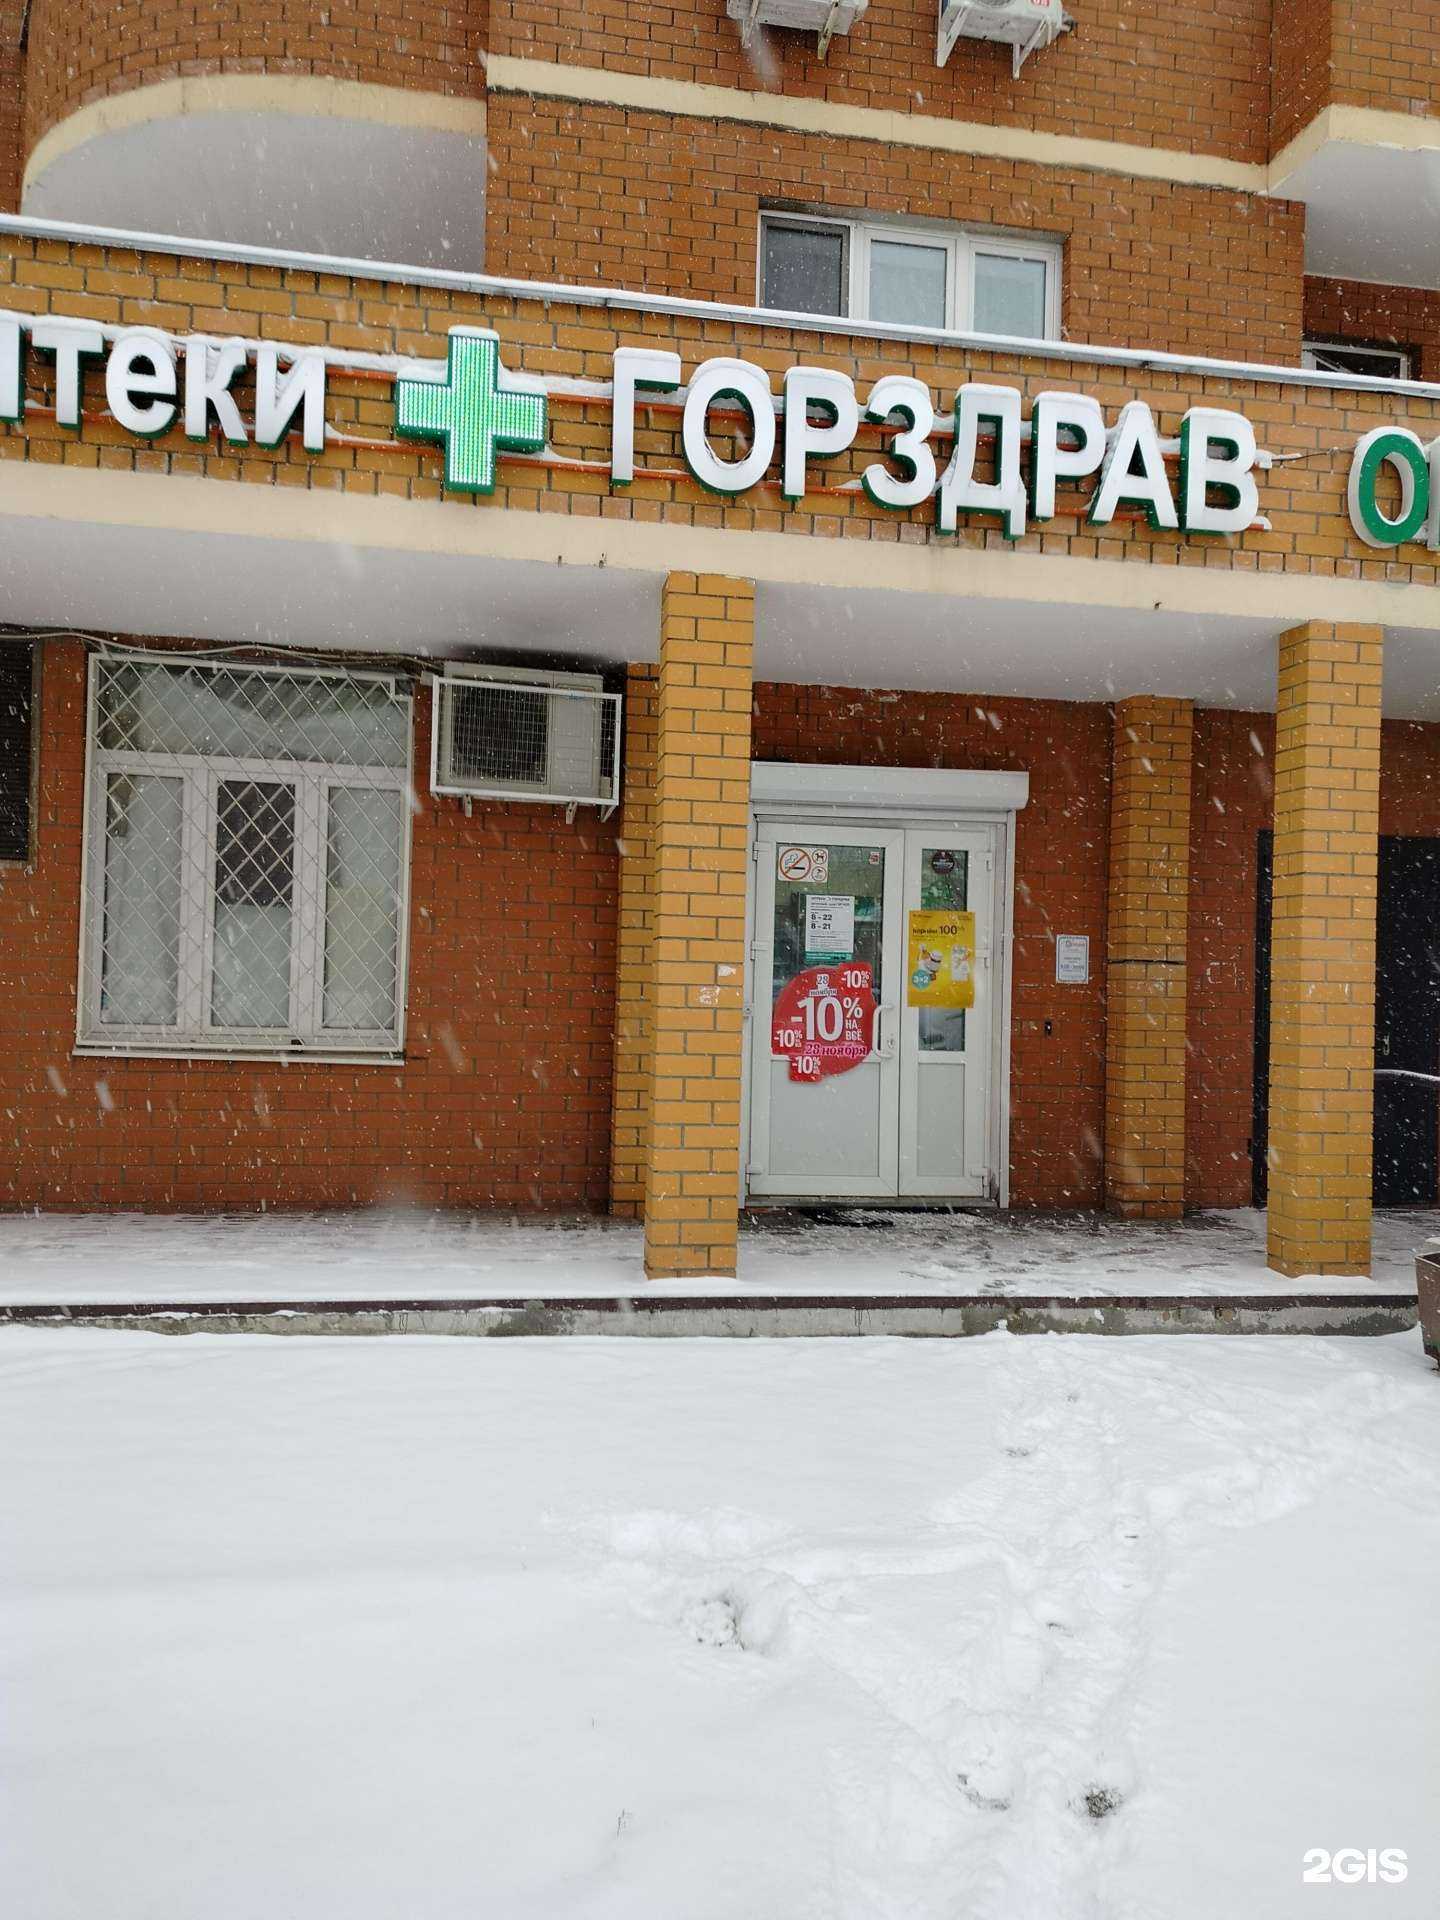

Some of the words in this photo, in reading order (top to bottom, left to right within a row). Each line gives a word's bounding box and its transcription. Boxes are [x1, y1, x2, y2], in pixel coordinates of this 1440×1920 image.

[610, 346, 1261, 540] ГОРЗДРАВ
[791, 997, 863, 1041] -10%
[845, 1019, 857, 1029] НА
[806, 1044, 820, 1055] 28
[822, 1045, 869, 1057] ноября
